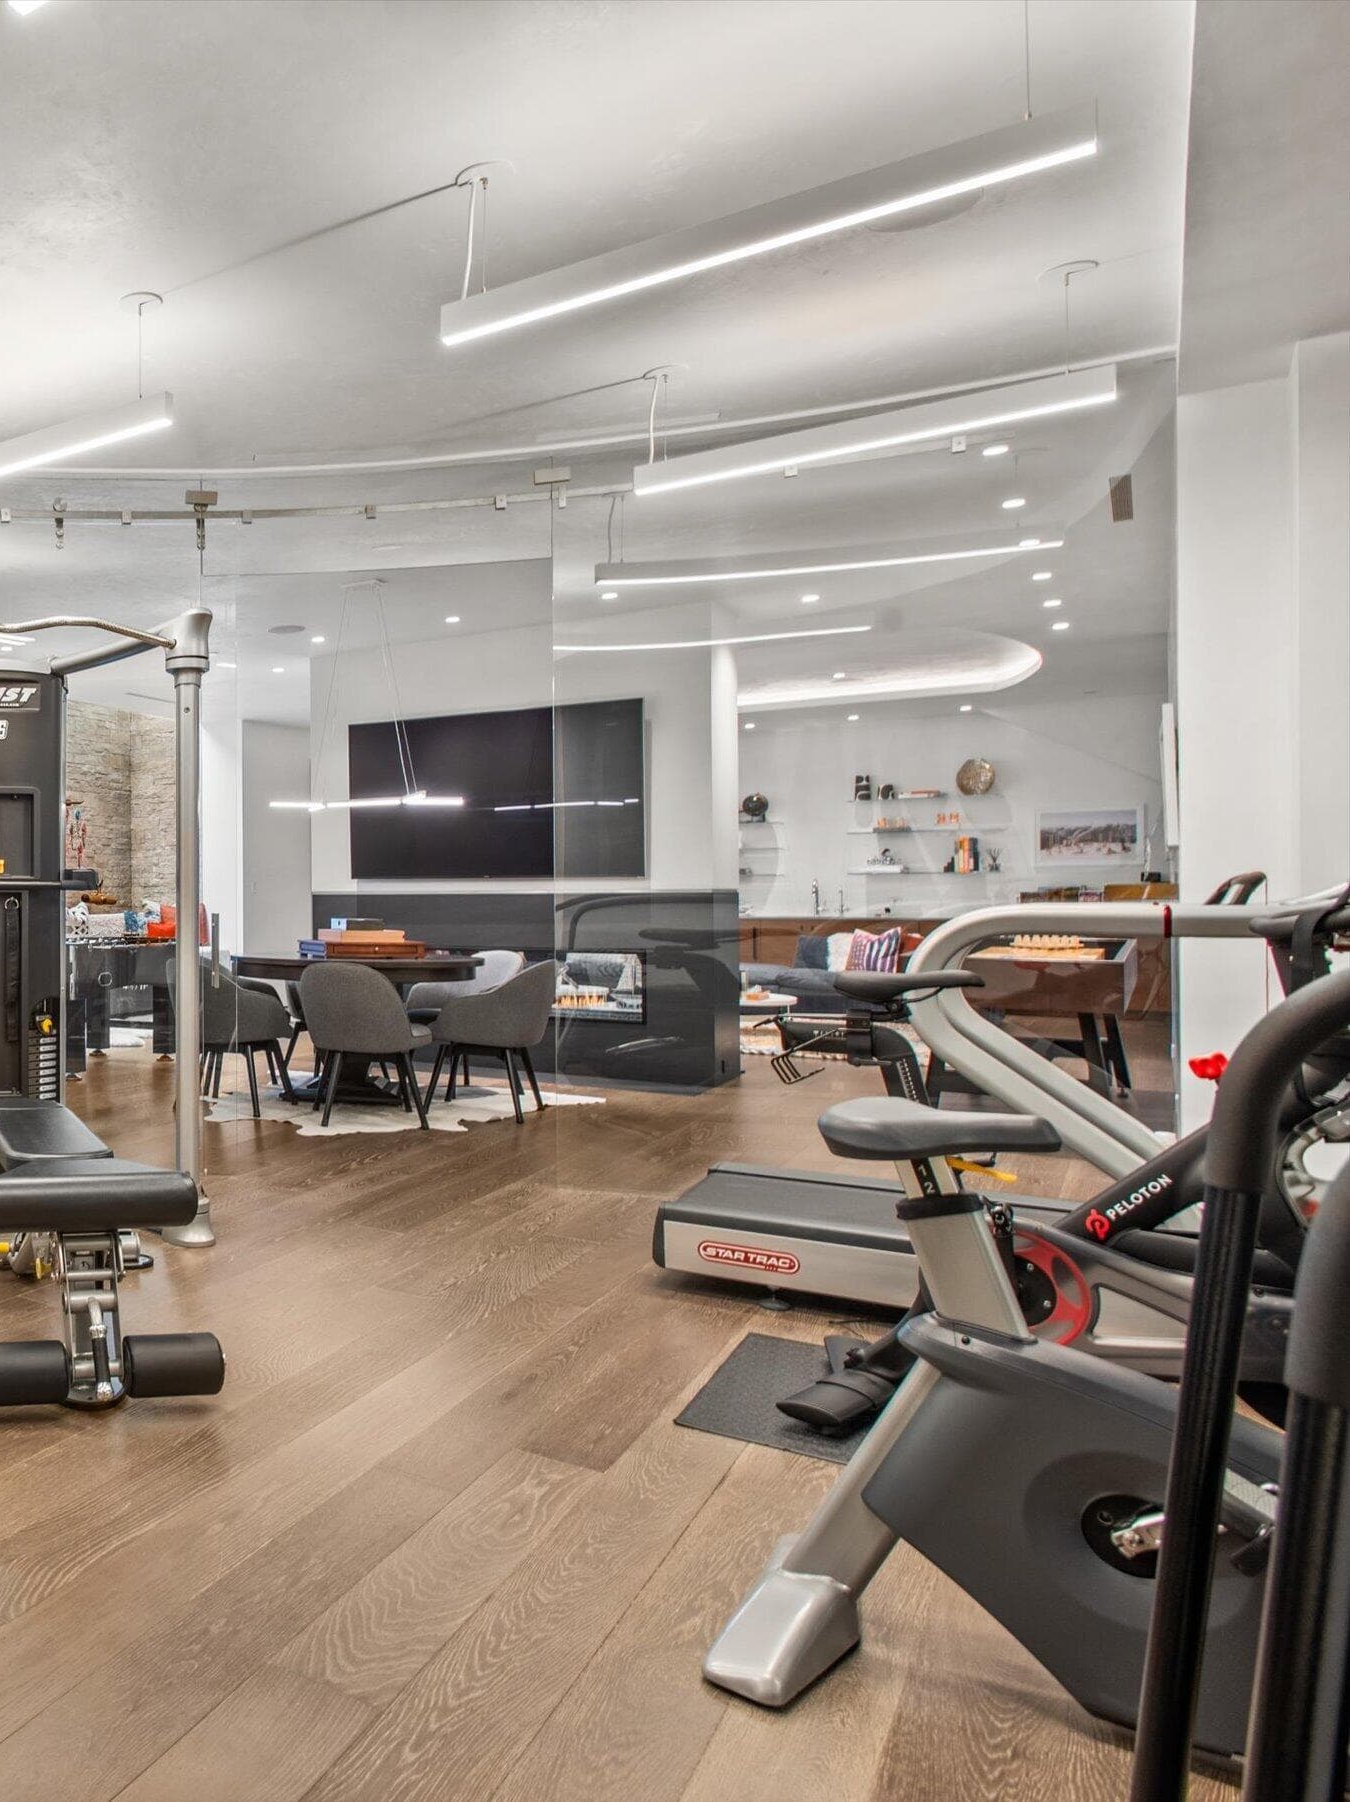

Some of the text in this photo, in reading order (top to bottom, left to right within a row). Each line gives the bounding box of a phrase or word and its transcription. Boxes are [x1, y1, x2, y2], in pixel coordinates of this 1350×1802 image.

[918, 1164, 927, 1177] 1
[924, 1182, 936, 1194] 2
[1105, 1174, 1173, 1221] PELOTON
[705, 1247, 745, 1261] STAR
[747, 1253, 791, 1268] TRAC
